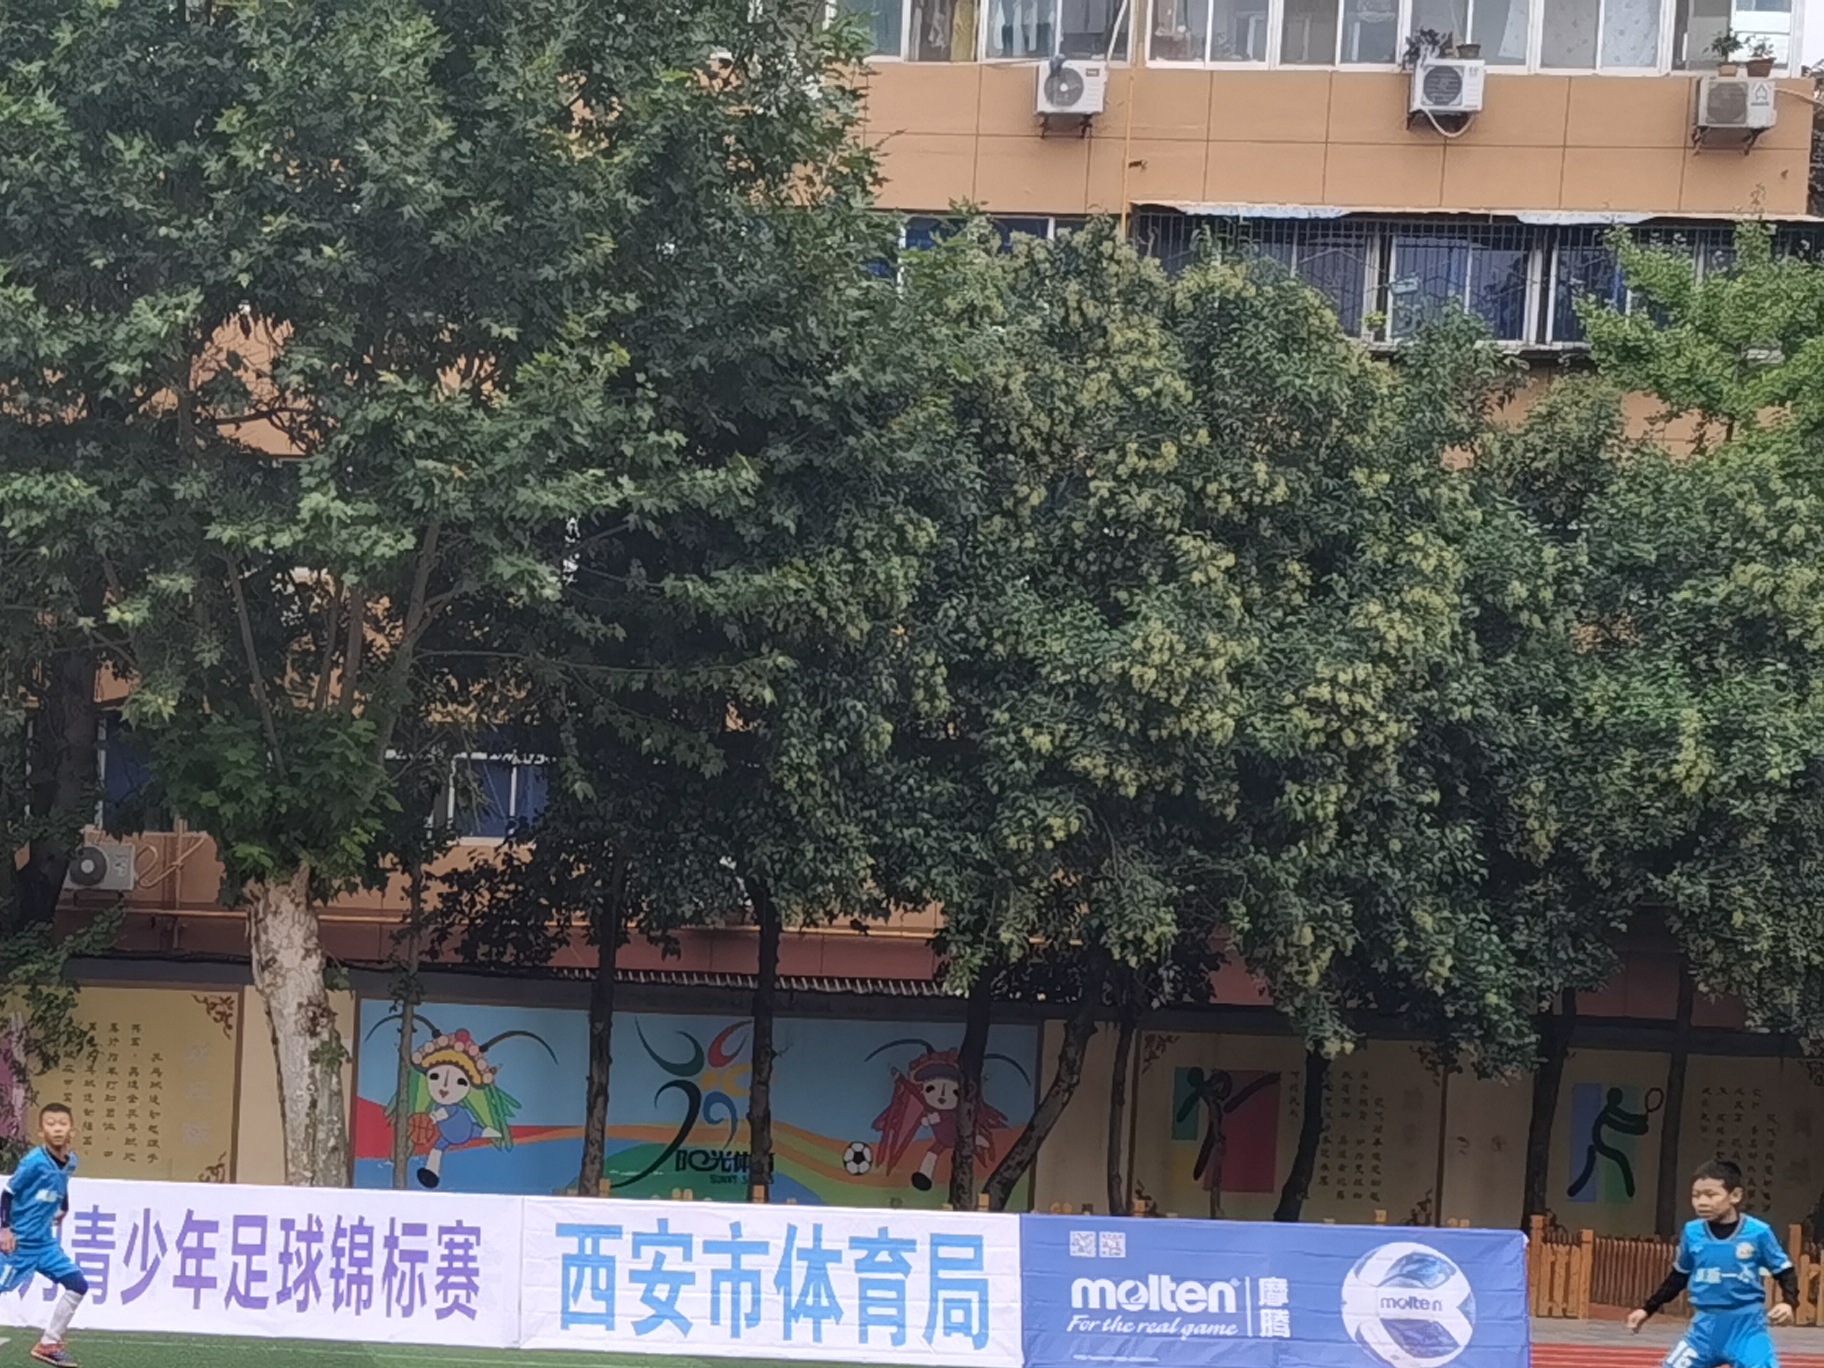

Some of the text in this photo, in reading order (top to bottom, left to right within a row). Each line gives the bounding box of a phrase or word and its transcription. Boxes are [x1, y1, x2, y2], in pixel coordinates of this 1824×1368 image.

[555, 1218, 991, 1351] 西安市体育局
[1071, 1273, 1237, 1313] molten
[1380, 1295, 1443, 1312] molten
[1066, 1314, 1239, 1341] For the real game
